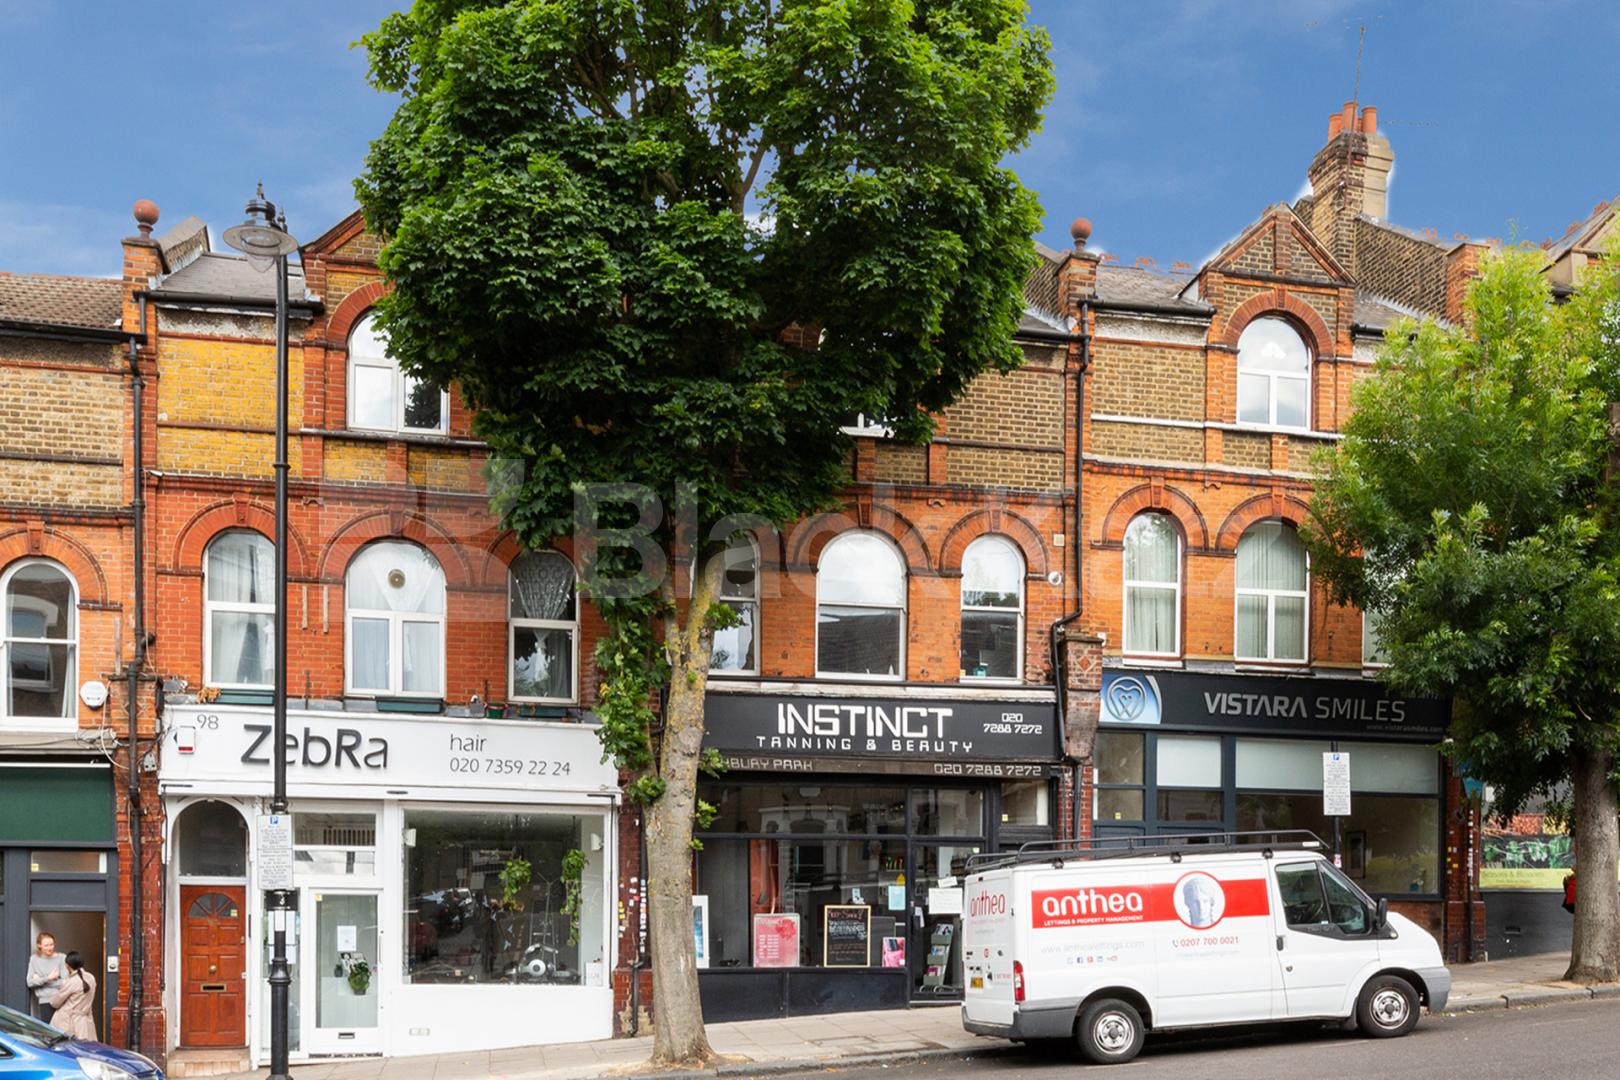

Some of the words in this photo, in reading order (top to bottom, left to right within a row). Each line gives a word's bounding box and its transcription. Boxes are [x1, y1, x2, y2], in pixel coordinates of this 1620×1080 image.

[1204, 692, 1308, 719] VISTARA
[1315, 697, 1406, 722] SMILES
[196, 714, 219, 730] 98
[778, 703, 953, 738] INSTINCT
[1002, 713, 1024, 723] 020
[983, 723, 1012, 734] 7288
[1014, 724, 1043, 734] 7272
[450, 733, 487, 752] hair
[757, 736, 851, 750] TANNING
[866, 739, 877, 751] &
[892, 740, 973, 753] BEAUTY
[450, 757, 480, 773] 020
[485, 759, 523, 774] 7359
[528, 760, 547, 775] 22
[552, 761, 571, 776] 24
[773, 758, 813, 771] PARK
[934, 763, 962, 775] 020
[966, 764, 1002, 776] 7288
[1006, 765, 1042, 776] 7272
[970, 890, 1006, 918] anthea
[1042, 888, 1143, 917] anthea
[1044, 919, 1071, 927] LETTINGS
[1105, 915, 1144, 923] MANAGEMENT
[1180, 938, 1200, 947] 0207
[1202, 937, 1218, 946] 700
[1220, 936, 1240, 945] 0021
